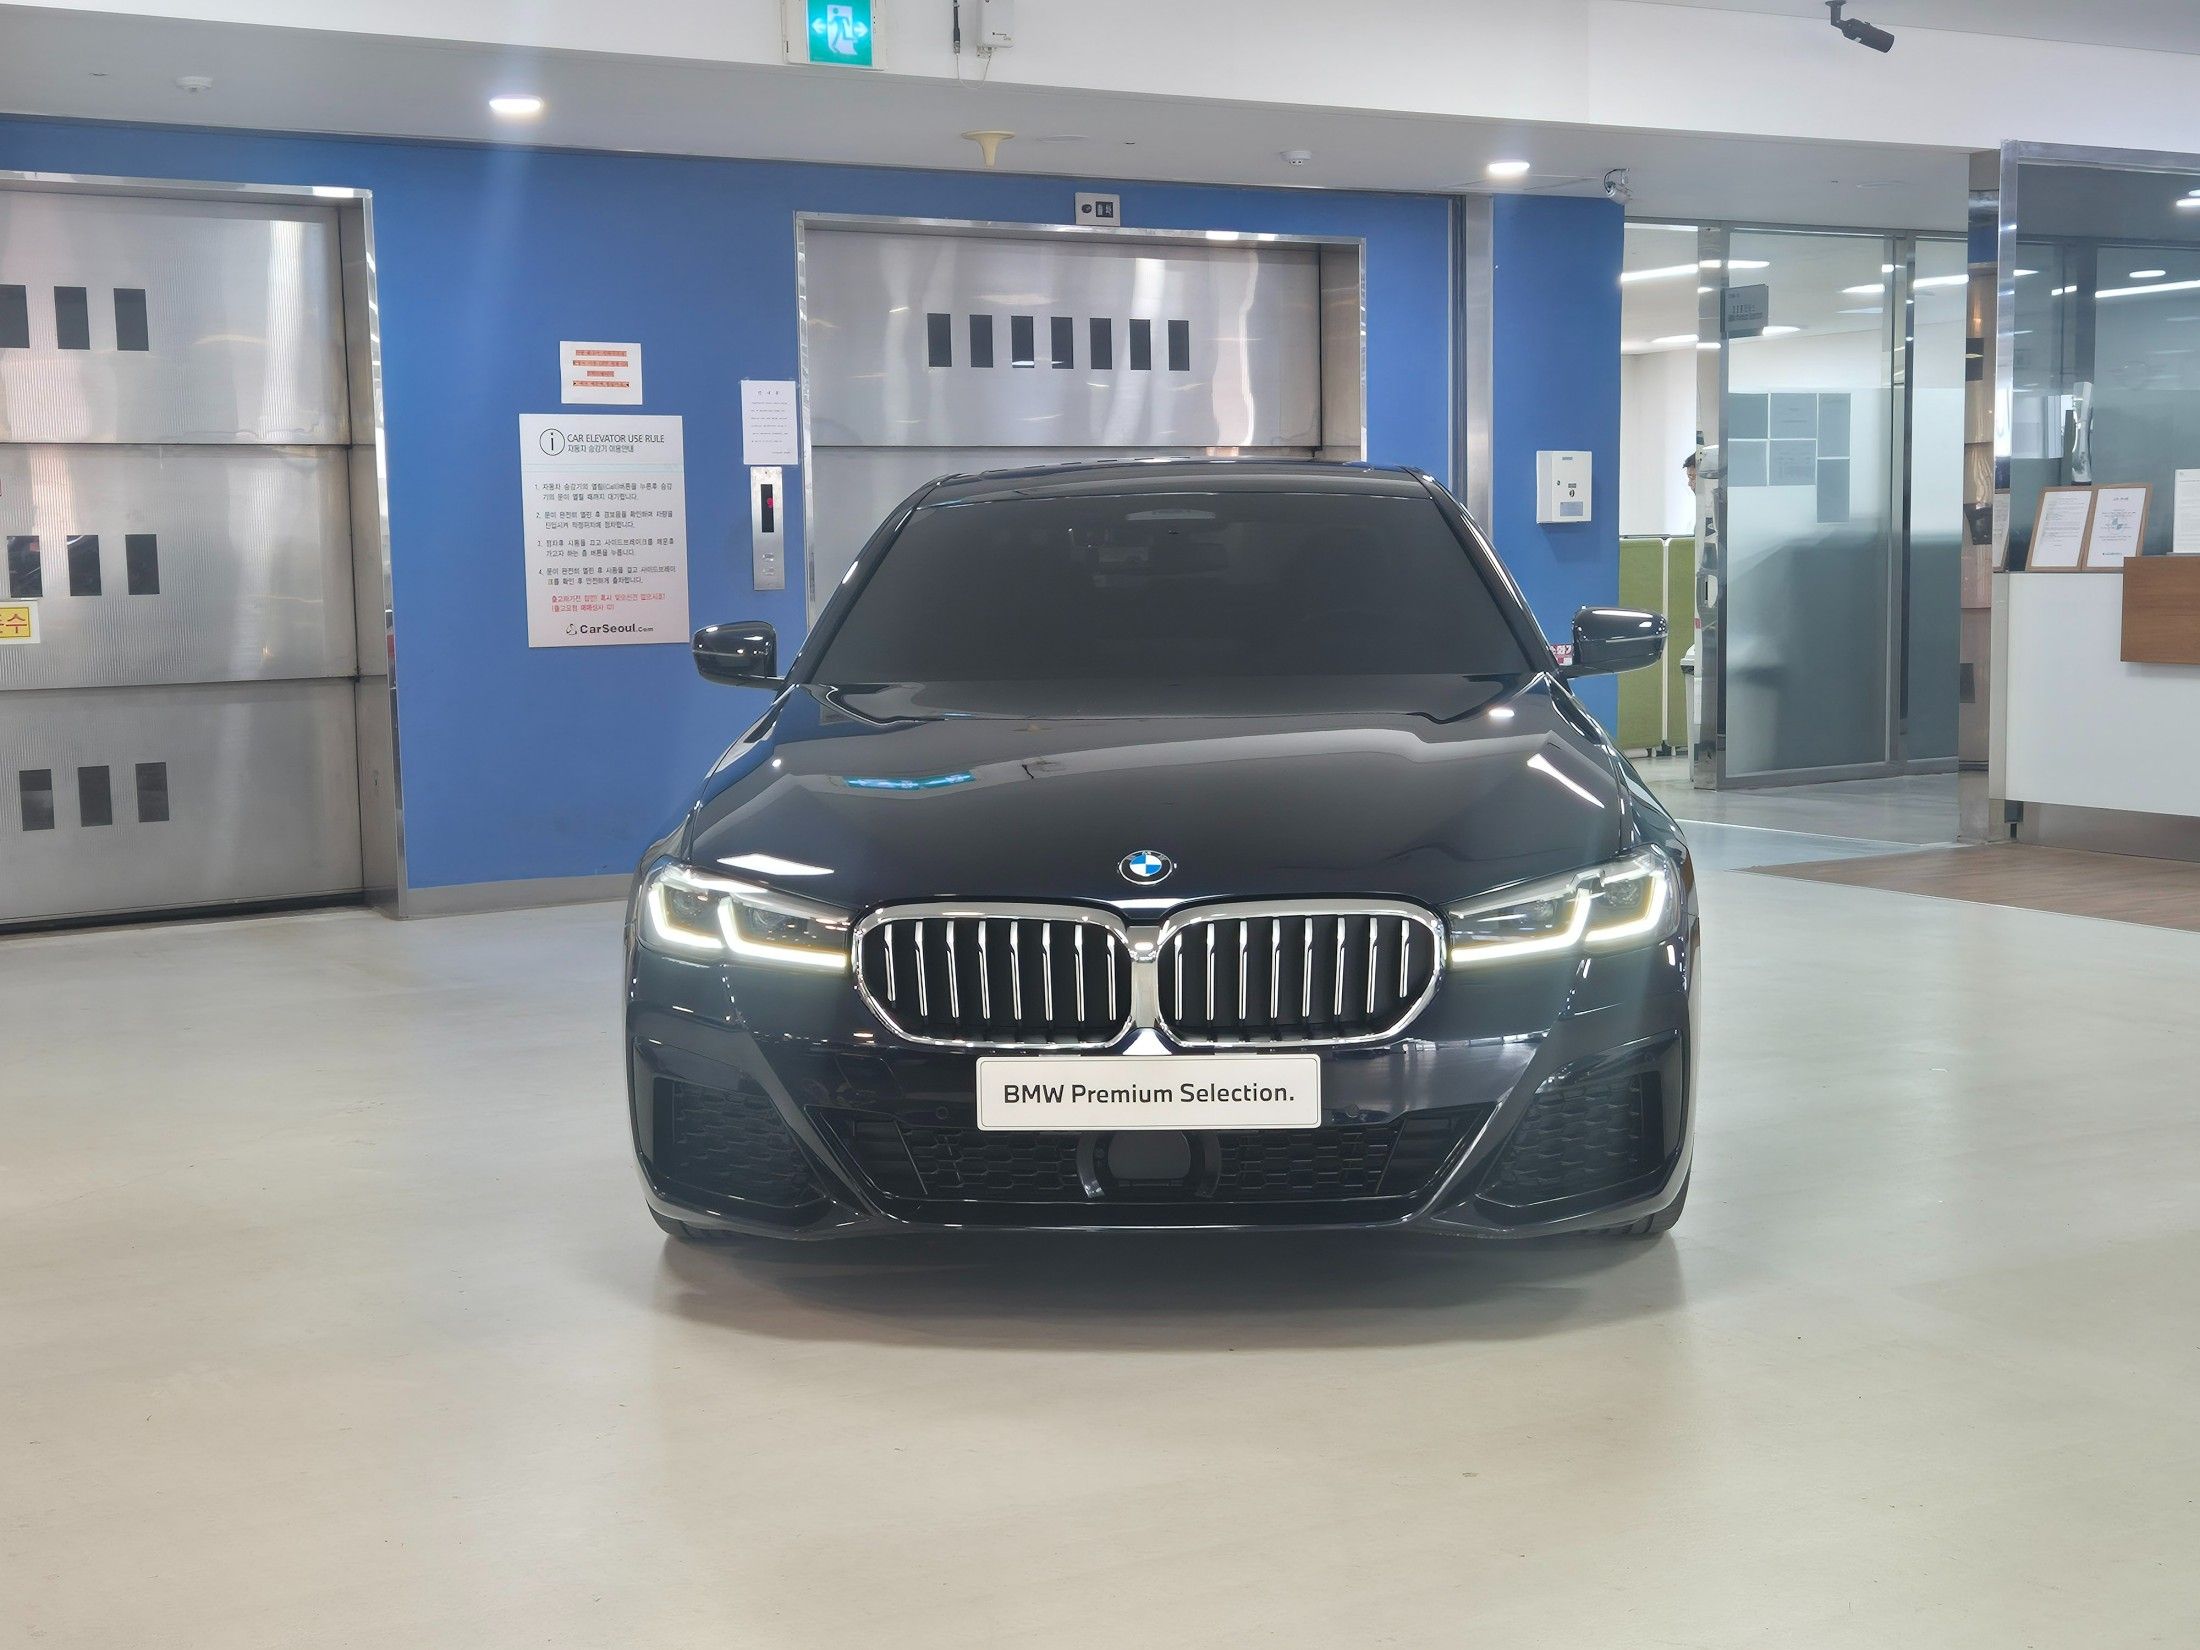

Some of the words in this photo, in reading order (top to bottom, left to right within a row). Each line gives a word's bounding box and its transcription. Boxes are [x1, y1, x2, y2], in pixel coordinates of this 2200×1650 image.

[567, 433, 584, 443] CAR
[586, 433, 626, 443] ELEVATOR
[628, 433, 643, 443] USE
[645, 433, 665, 443] RULE
[1003, 1084, 1064, 1104] BMW
[1071, 1083, 1173, 1104] Premium
[1179, 1082, 1296, 1103] Selection.
